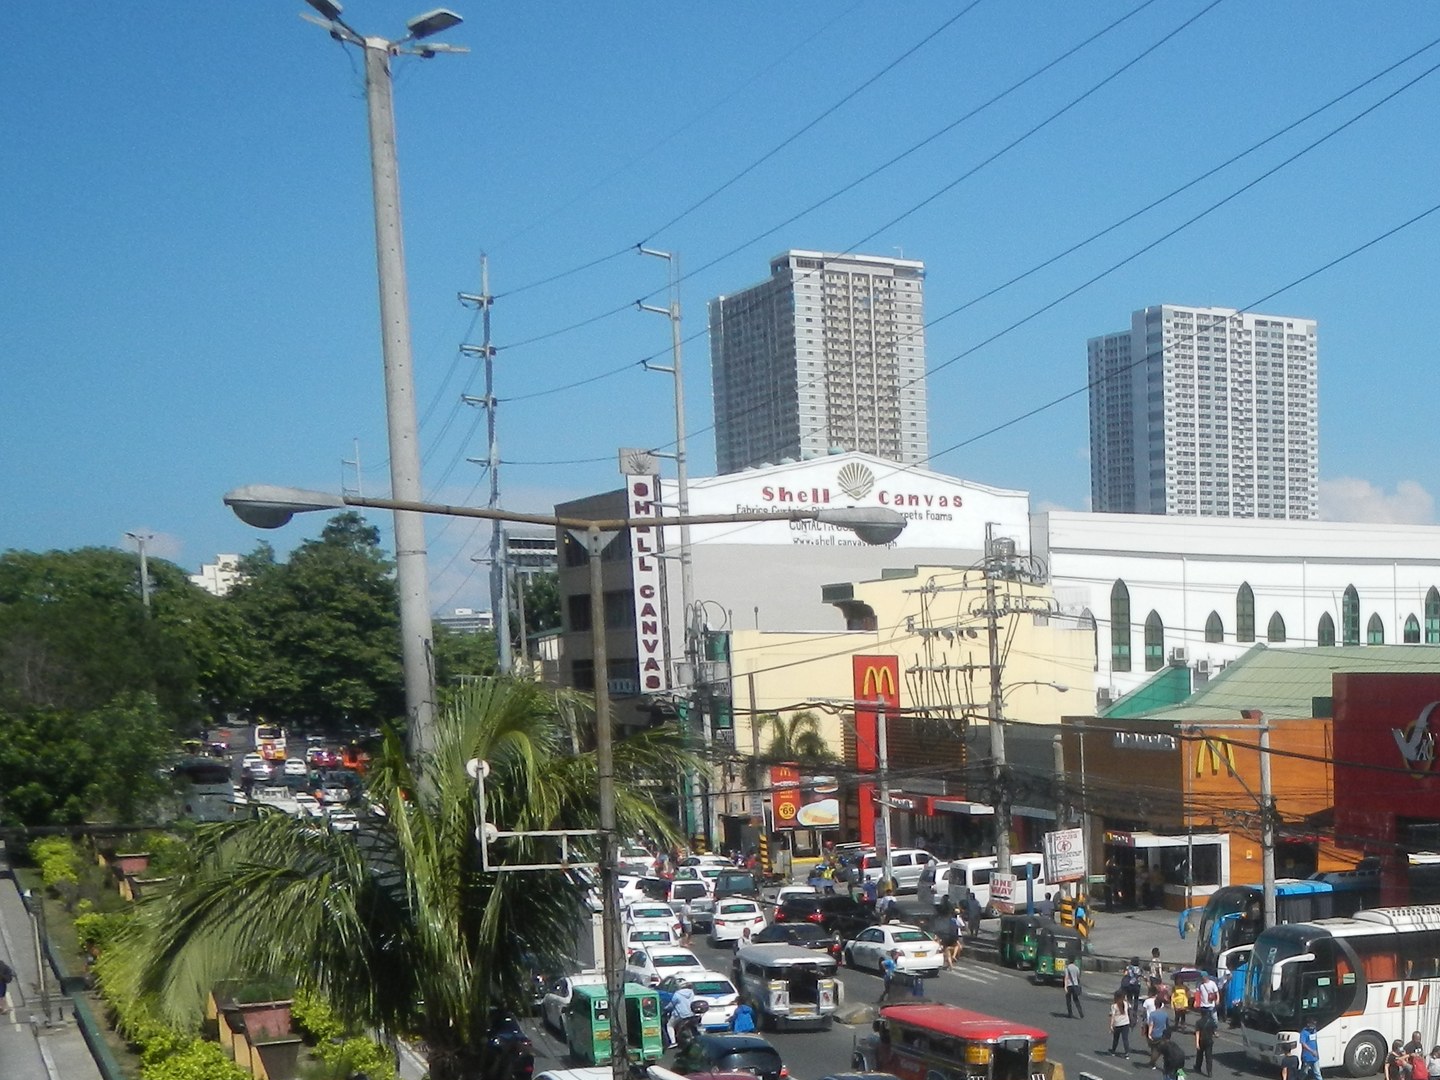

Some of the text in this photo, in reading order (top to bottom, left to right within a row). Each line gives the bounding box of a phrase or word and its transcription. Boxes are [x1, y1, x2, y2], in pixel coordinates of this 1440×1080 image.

[762, 486, 963, 508] Shell Canvas
[925, 509, 953, 521] Foams
[639, 584, 661, 689] CANVAS
[991, 886, 1013, 896] WAY
[992, 879, 1013, 888] ONE
[1387, 984, 1431, 1008] LLI
